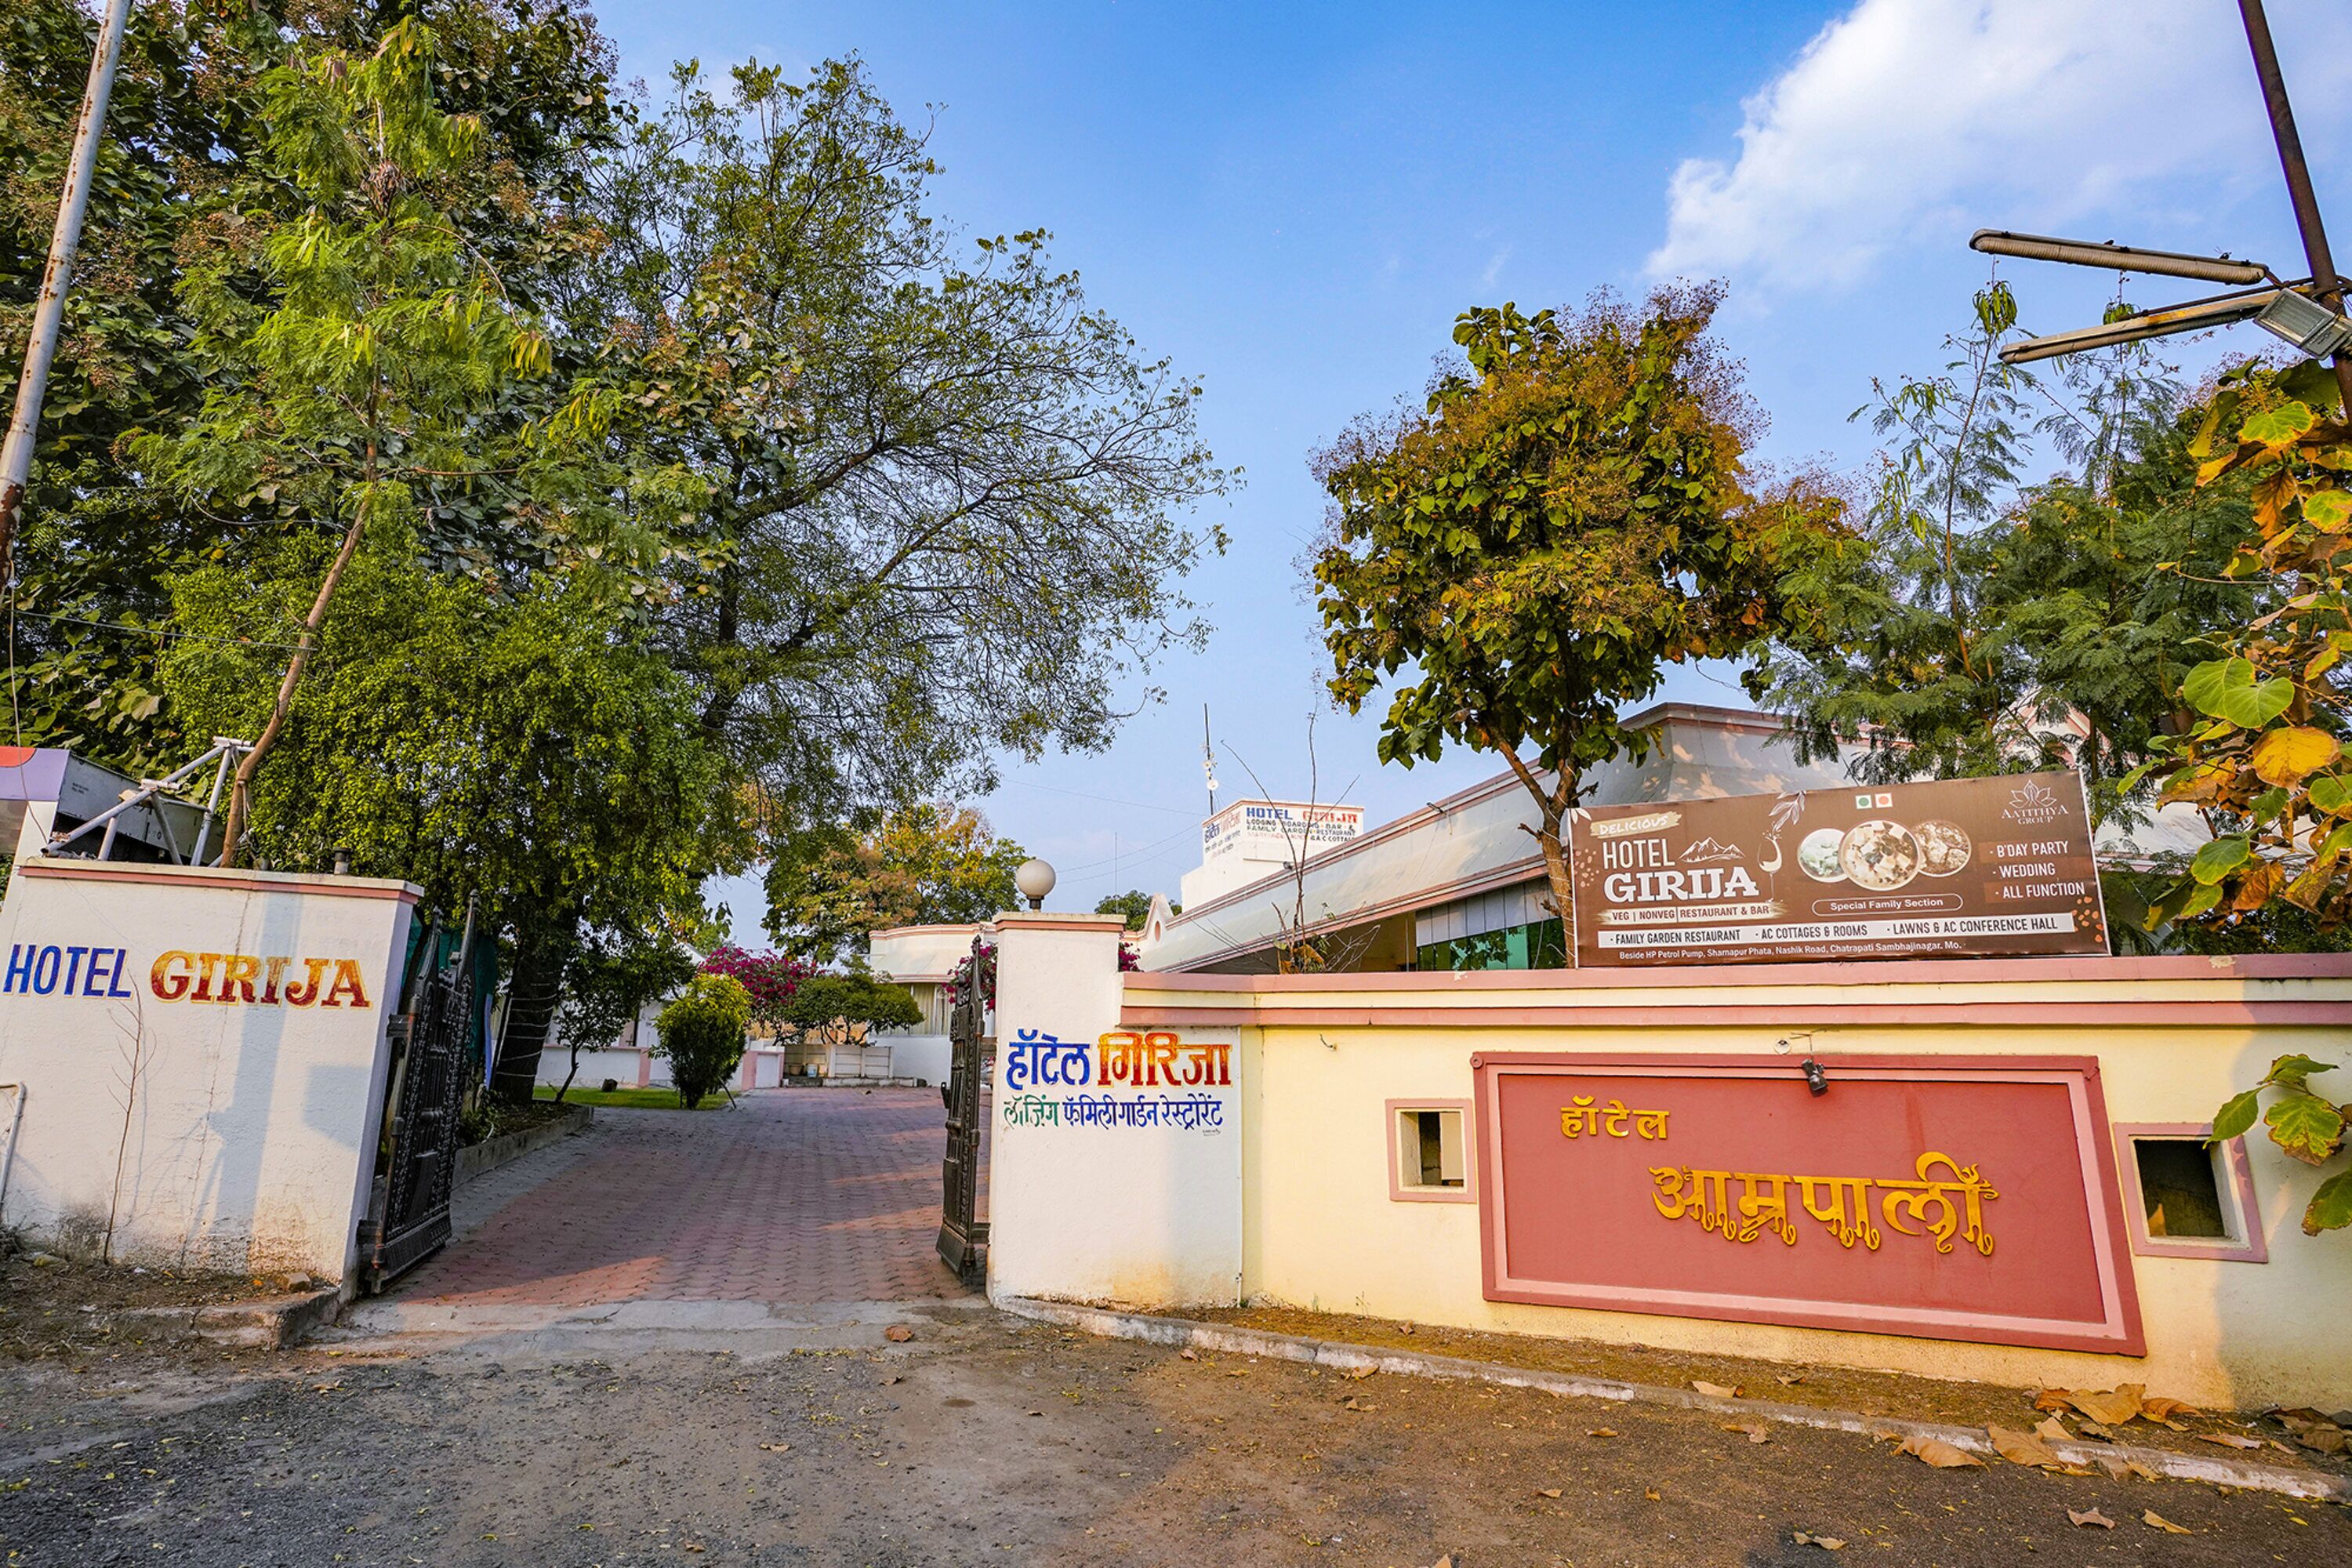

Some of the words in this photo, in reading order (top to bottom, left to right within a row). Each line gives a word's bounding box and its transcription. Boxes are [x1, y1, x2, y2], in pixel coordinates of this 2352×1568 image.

[1247, 807, 1293, 820] HOTEL
[2002, 804, 2069, 819] AATITHYA
[2017, 815, 2054, 825] GROUP
[1599, 815, 1669, 836] DELICIOUS
[1602, 838, 1675, 869] HOTEL
[1996, 844, 2028, 858] B'DAY
[2031, 840, 2069, 855] PARTY
[1998, 862, 2056, 878] WEDDING
[1603, 866, 1760, 903] GIRIJA
[2002, 885, 2024, 899] ALL
[2026, 882, 2085, 898] FUNCTION
[1612, 911, 1630, 920] VEG
[1639, 909, 1675, 920] NONVEG
[1680, 907, 1738, 918] RESTAURANT
[1740, 906, 1748, 915] &
[1750, 905, 1769, 914] BAR
[1830, 902, 1867, 913] Special
[1869, 900, 1901, 910] Family
[1904, 898, 1944, 908] Section
[1615, 933, 1645, 945] FAMILY
[1646, 931, 1682, 944] GARDEN
[1685, 929, 1740, 942] RESTAURANT
[1761, 928, 1773, 939] AC
[1775, 926, 1821, 939] COTTAGES
[1824, 926, 1831, 937] &
[1834, 924, 1867, 937] ROOMS
[1893, 921, 1930, 935] LAWNS
[1933, 921, 1940, 933] &
[1944, 920, 1957, 932] AC
[1960, 918, 2028, 932] CONFERENCE
[2031, 917, 2058, 930] HALL
[1619, 951, 1644, 960] Beside
[1657, 949, 1679, 958] Petrol
[1681, 949, 1706, 960] Pump,
[1775, 945, 1803, 955] Nashik
[1830, 942, 1873, 954] Chatrapati
[2, 943, 132, 999] HOTEL
[151, 949, 373, 1009] GIRIJA
[1006, 1029, 1091, 1091] हॉटेल
[1097, 1032, 1233, 1088] गिरिजा
[1119, 1094, 1160, 1127] गार्डन
[1559, 1094, 1670, 1141] हॉटेल
[1648, 1151, 1999, 1257] आम्रपाली
